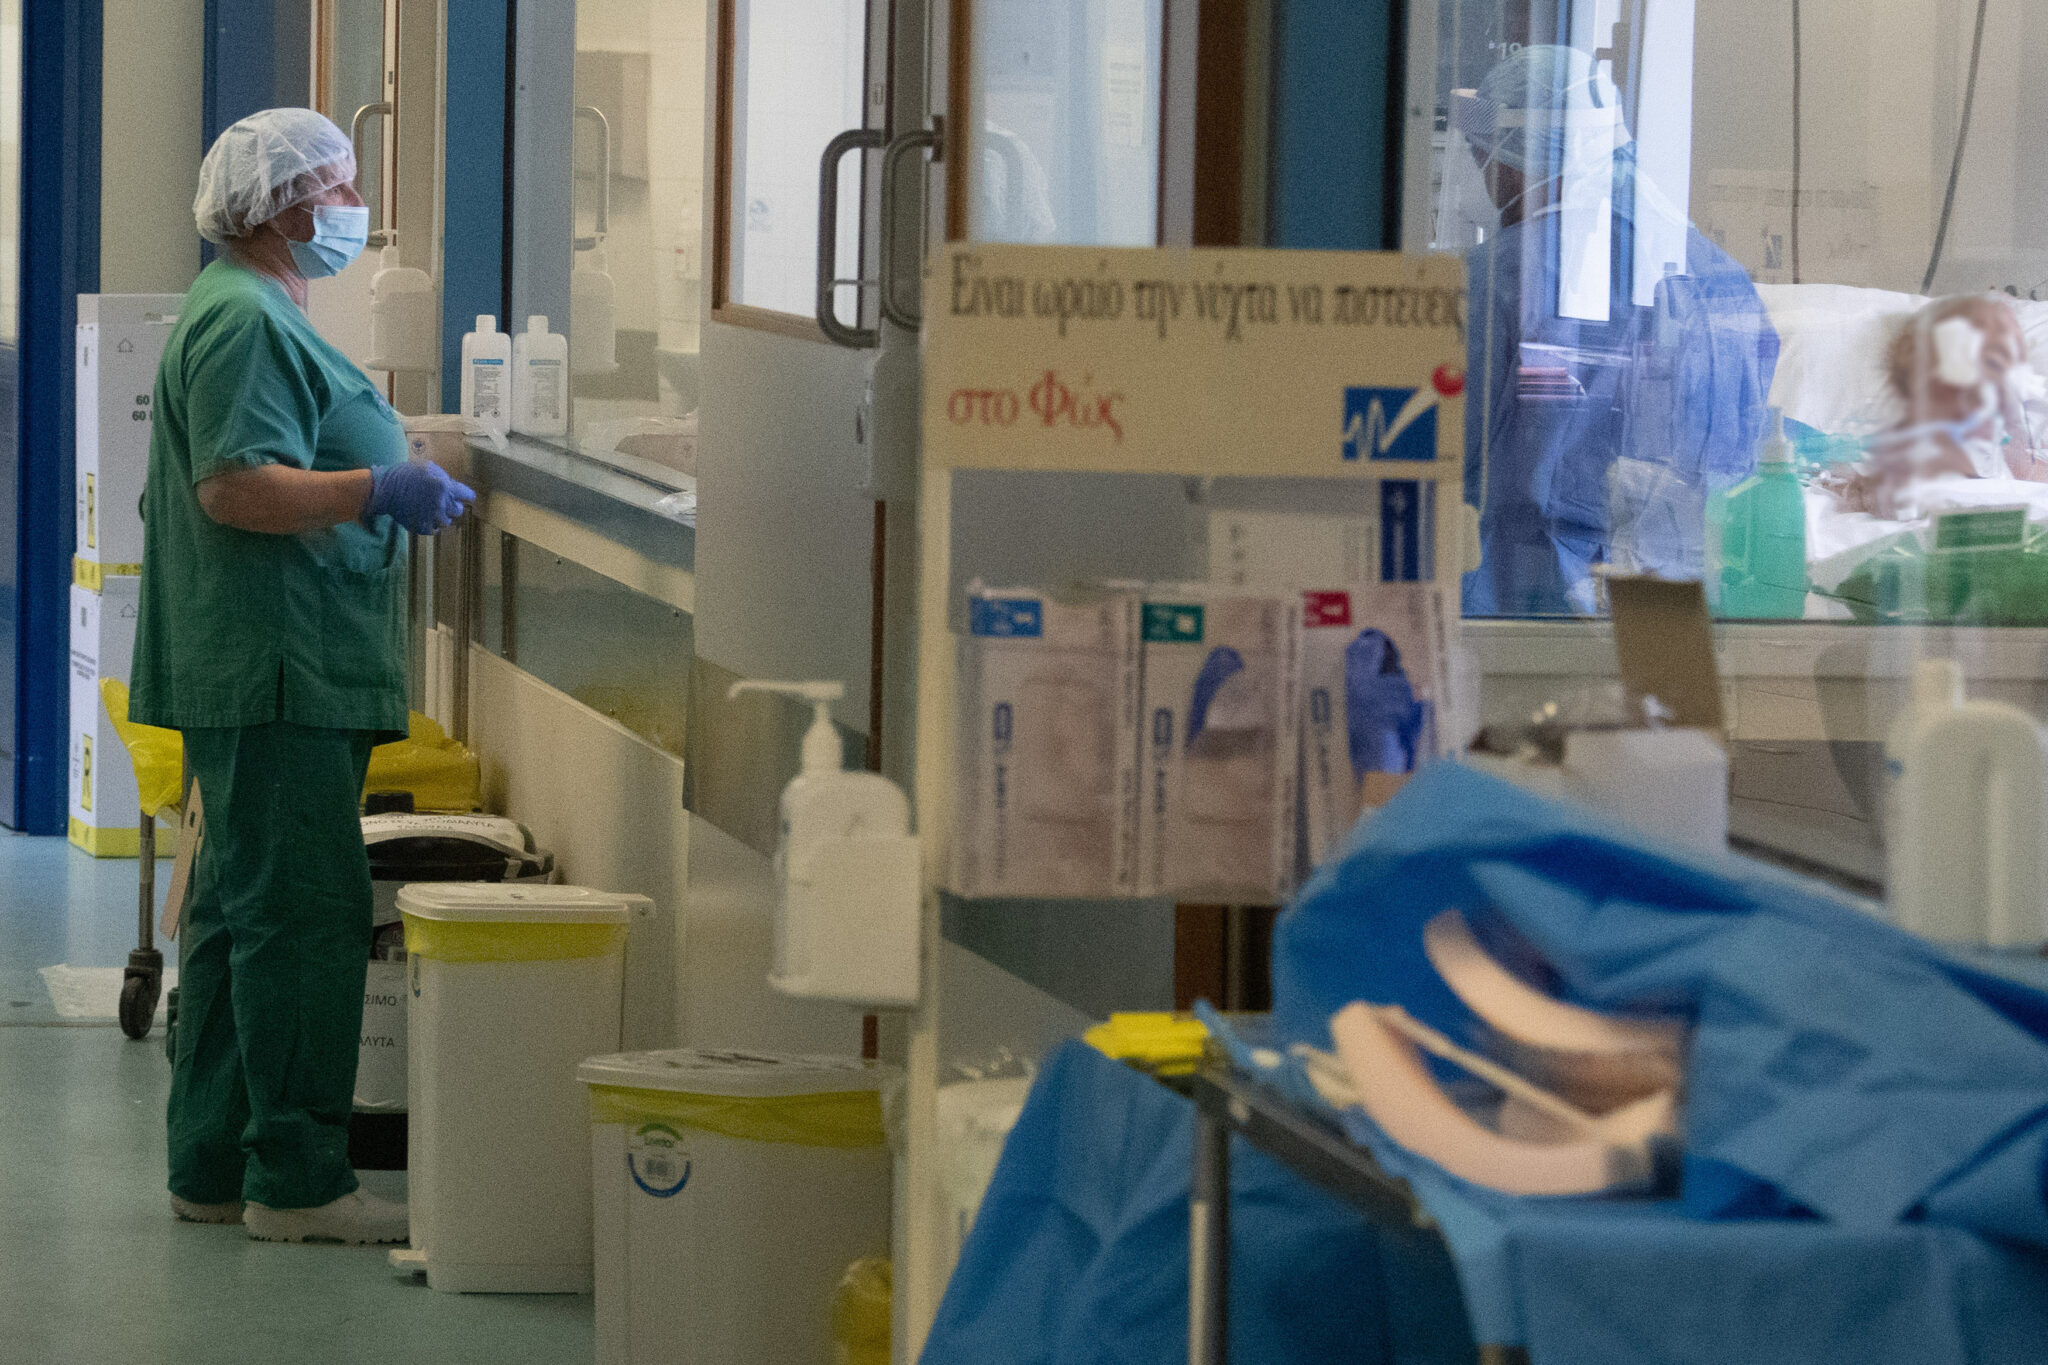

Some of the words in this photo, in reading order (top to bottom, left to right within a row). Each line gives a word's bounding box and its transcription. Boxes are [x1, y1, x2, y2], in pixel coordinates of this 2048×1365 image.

[136, 394, 150, 406] 60
[948, 388, 1020, 427] στο
[132, 410, 147, 421] 60
